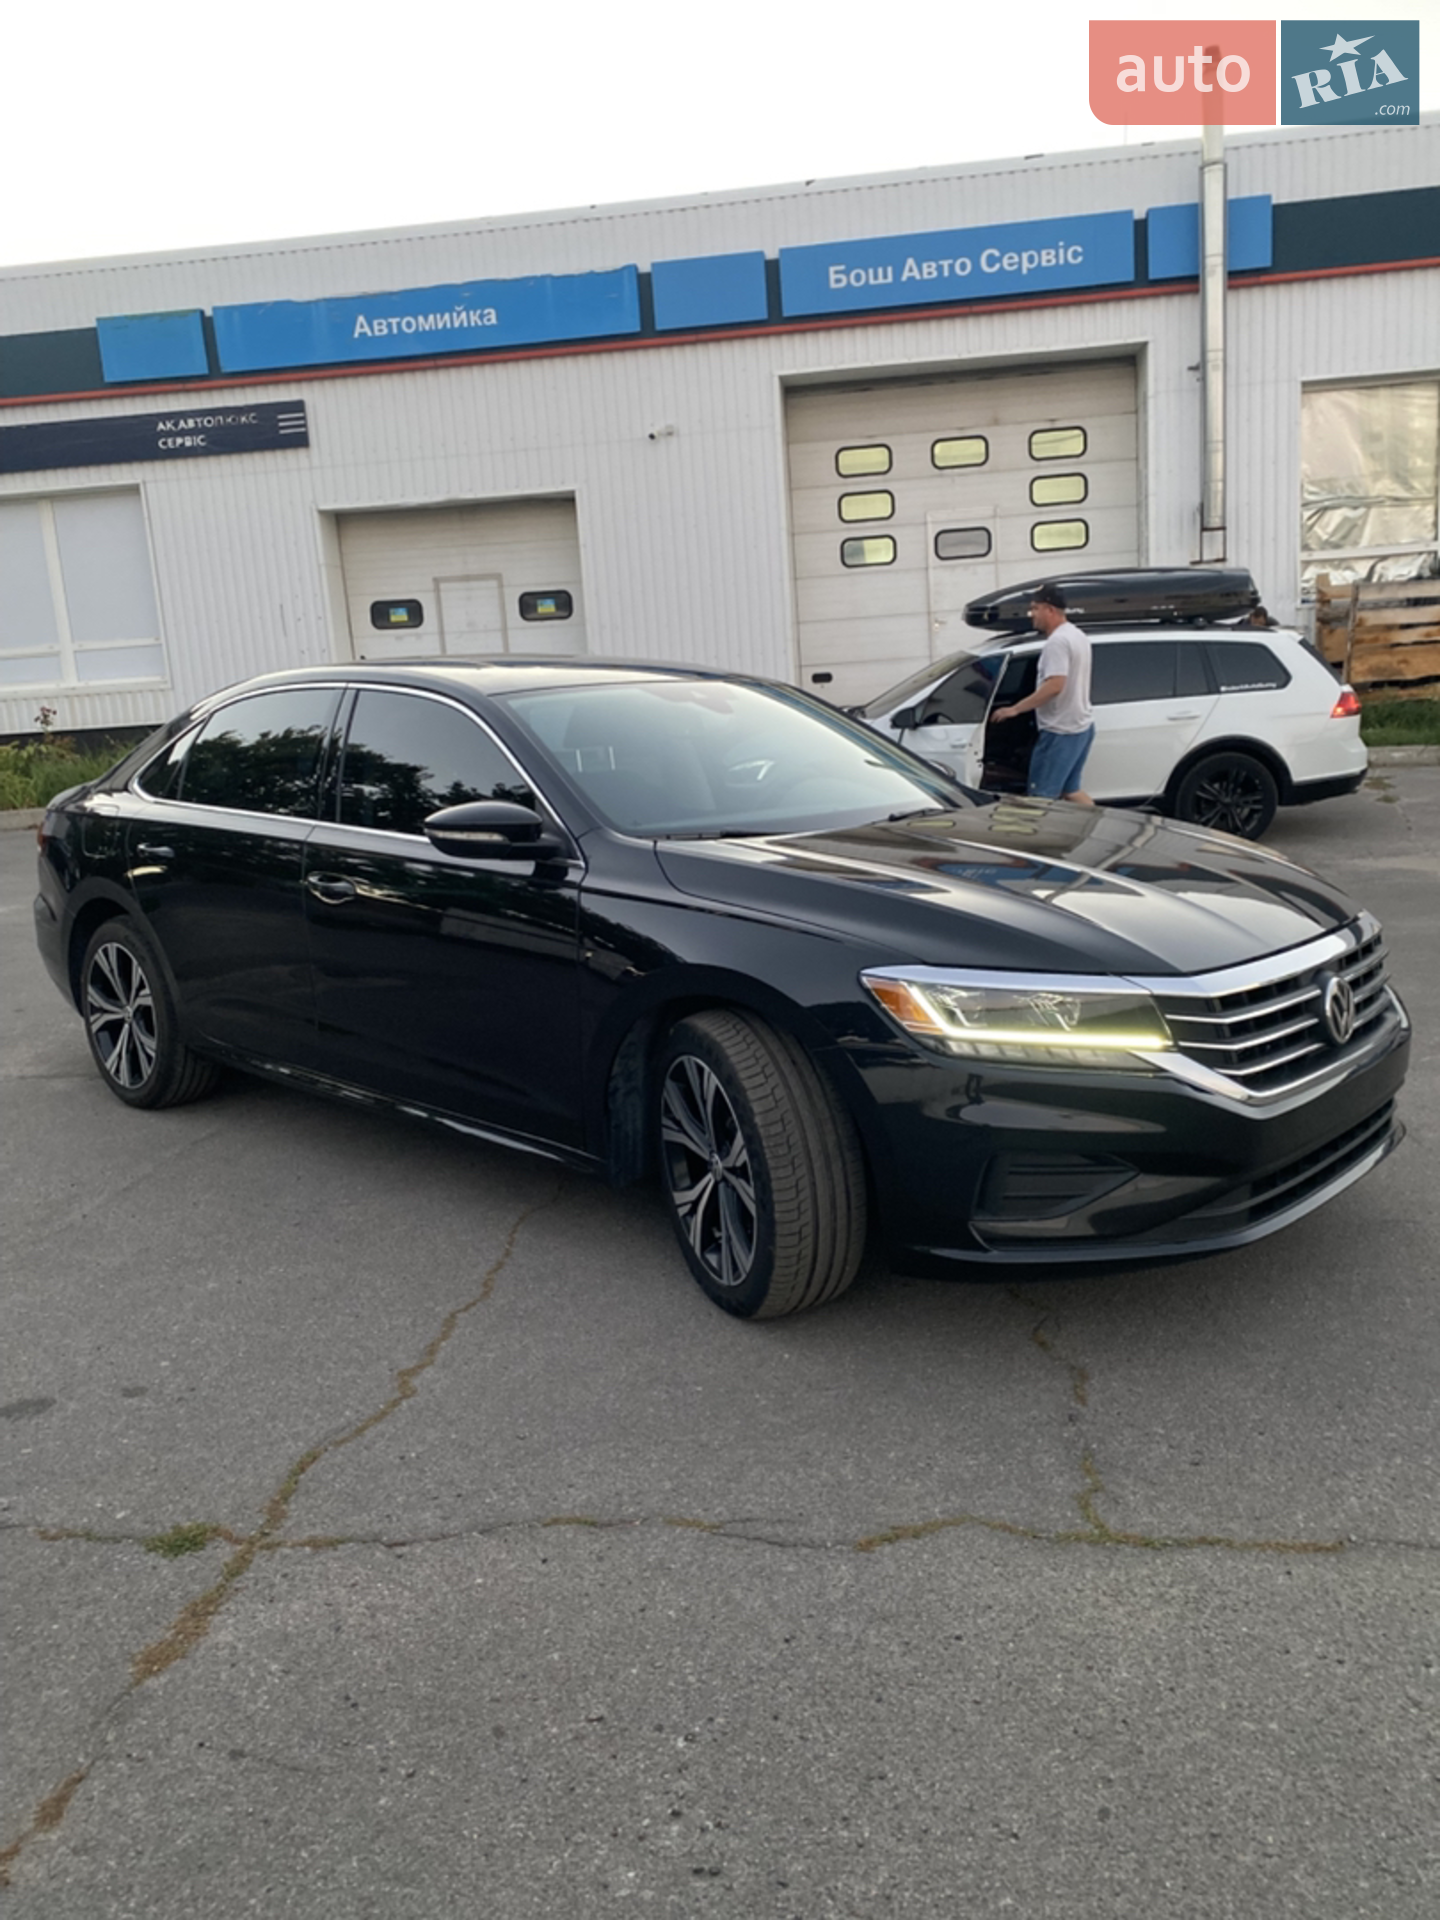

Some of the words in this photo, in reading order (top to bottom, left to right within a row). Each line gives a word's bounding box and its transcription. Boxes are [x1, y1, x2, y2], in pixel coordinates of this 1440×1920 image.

[828, 265, 893, 289] Бош
[901, 257, 972, 282] Авто
[980, 241, 1083, 275] Сервіс
[353, 305, 497, 338] Автомийка
[158, 435, 207, 449] СЕРВІС
